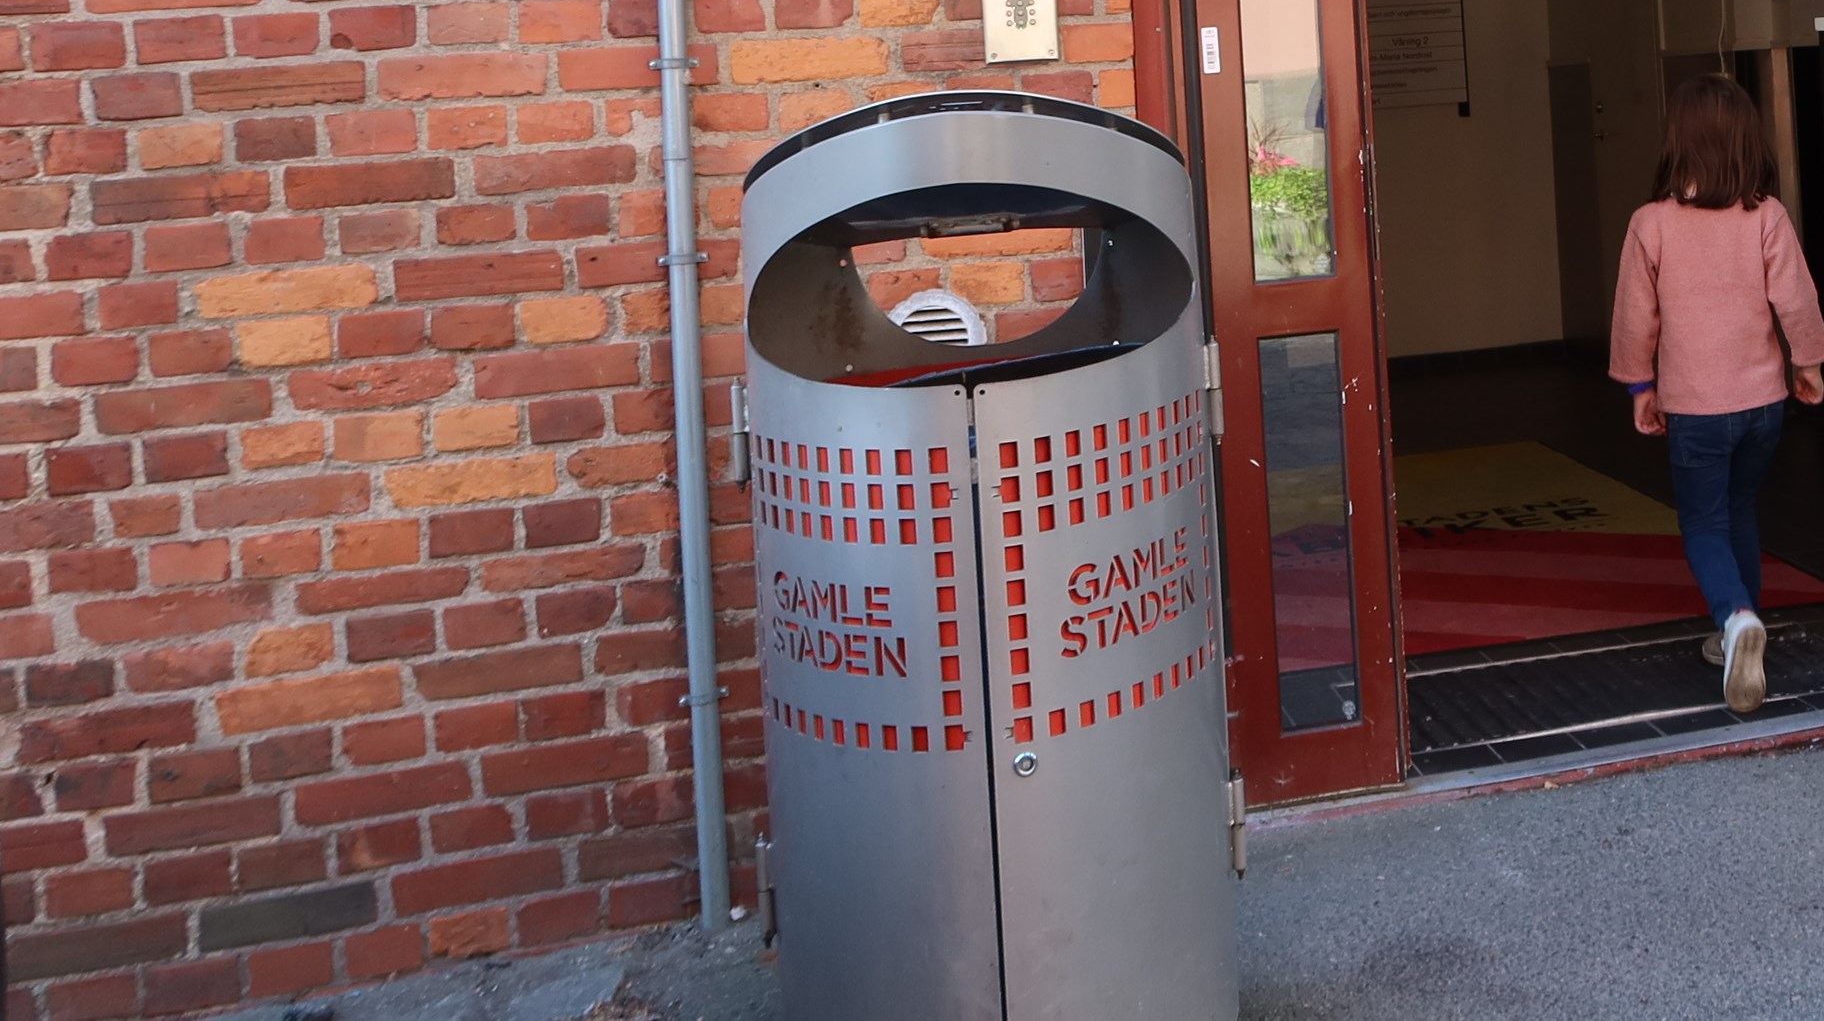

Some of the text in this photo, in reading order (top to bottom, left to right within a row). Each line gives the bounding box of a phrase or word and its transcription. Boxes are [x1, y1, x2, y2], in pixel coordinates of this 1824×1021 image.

[1391, 36, 1429, 48] Våning 2
[1068, 526, 1189, 606] GAMLE
[774, 571, 892, 627] GAMLE
[1060, 568, 1196, 658] STADEN
[773, 616, 907, 678] STADEN
